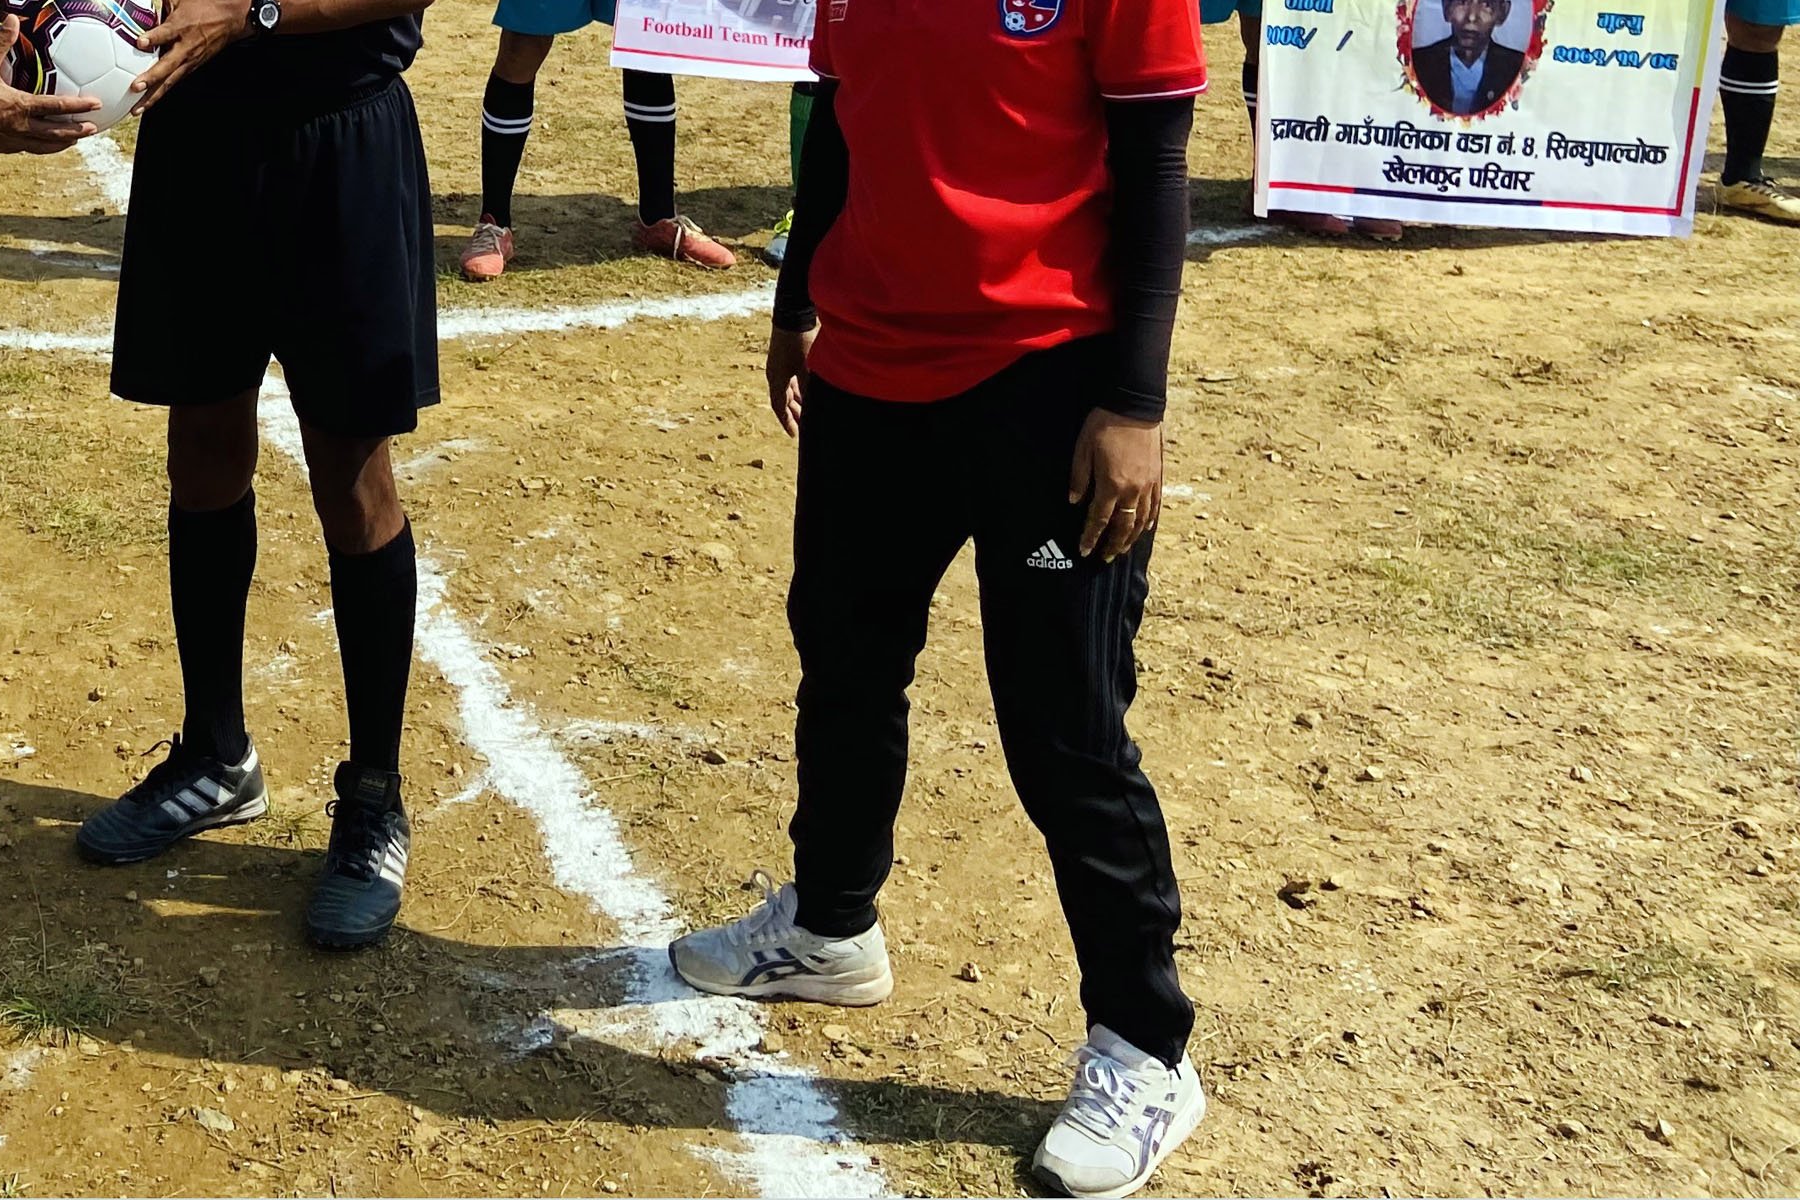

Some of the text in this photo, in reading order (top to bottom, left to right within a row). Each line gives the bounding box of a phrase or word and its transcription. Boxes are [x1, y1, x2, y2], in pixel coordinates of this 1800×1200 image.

[643, 16, 713, 40] Football
[719, 26, 768, 46] Team
[1335, 116, 1452, 151] गाउँपालिका
[1456, 132, 1492, 154] वडा
[1382, 155, 1535, 191] खेलकुद परिवार
[1026, 557, 1073, 569] adidas
